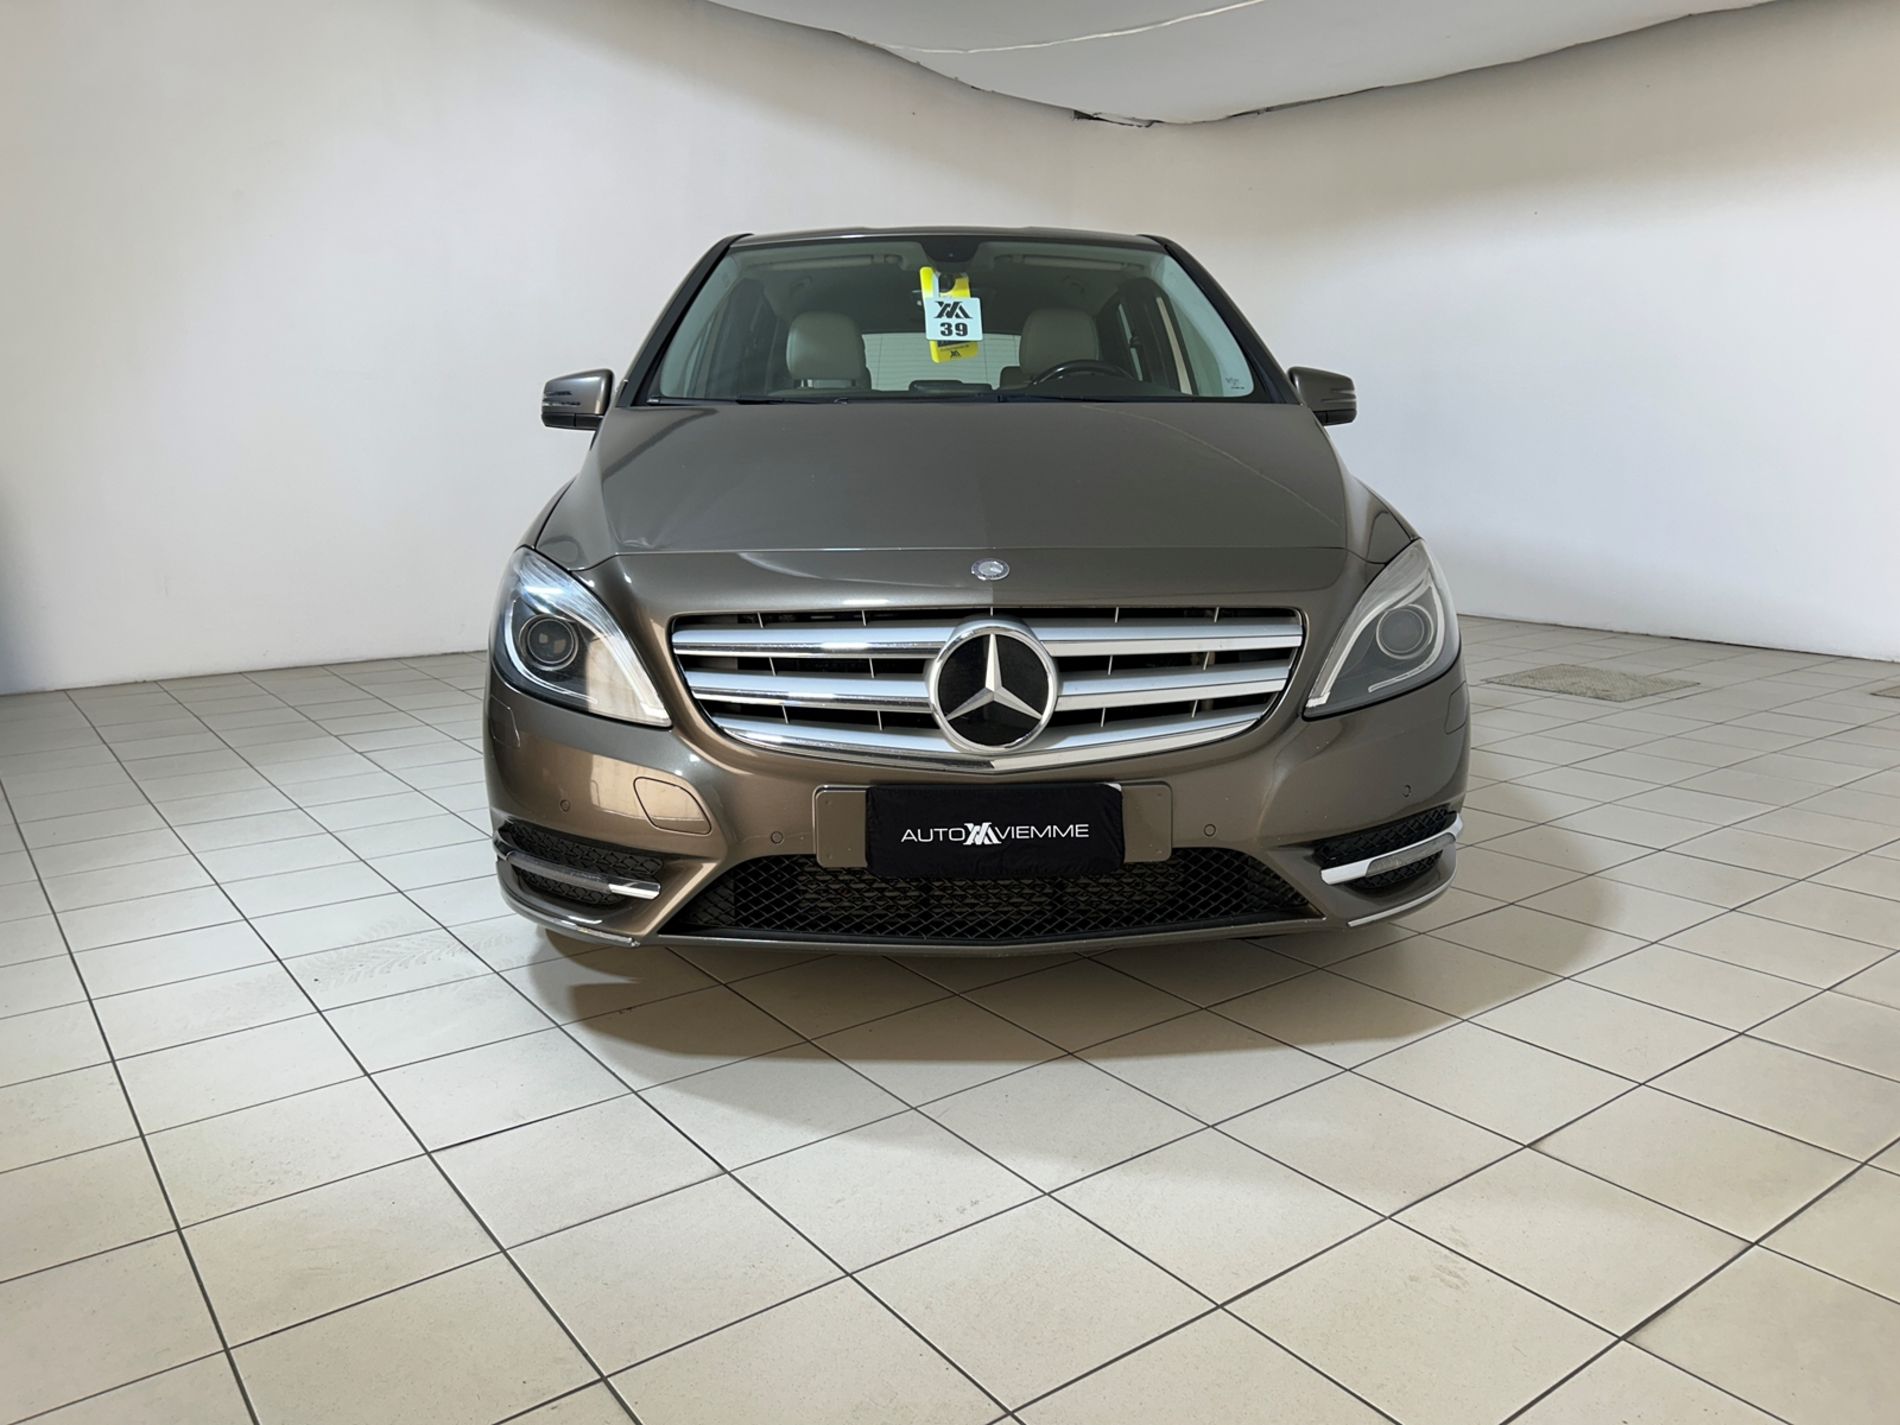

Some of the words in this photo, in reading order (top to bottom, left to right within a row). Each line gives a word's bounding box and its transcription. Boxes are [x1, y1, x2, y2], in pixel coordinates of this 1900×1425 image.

[940, 322, 968, 337] 39
[901, 828, 964, 843] AUTO
[994, 823, 1089, 839] VIEMME
